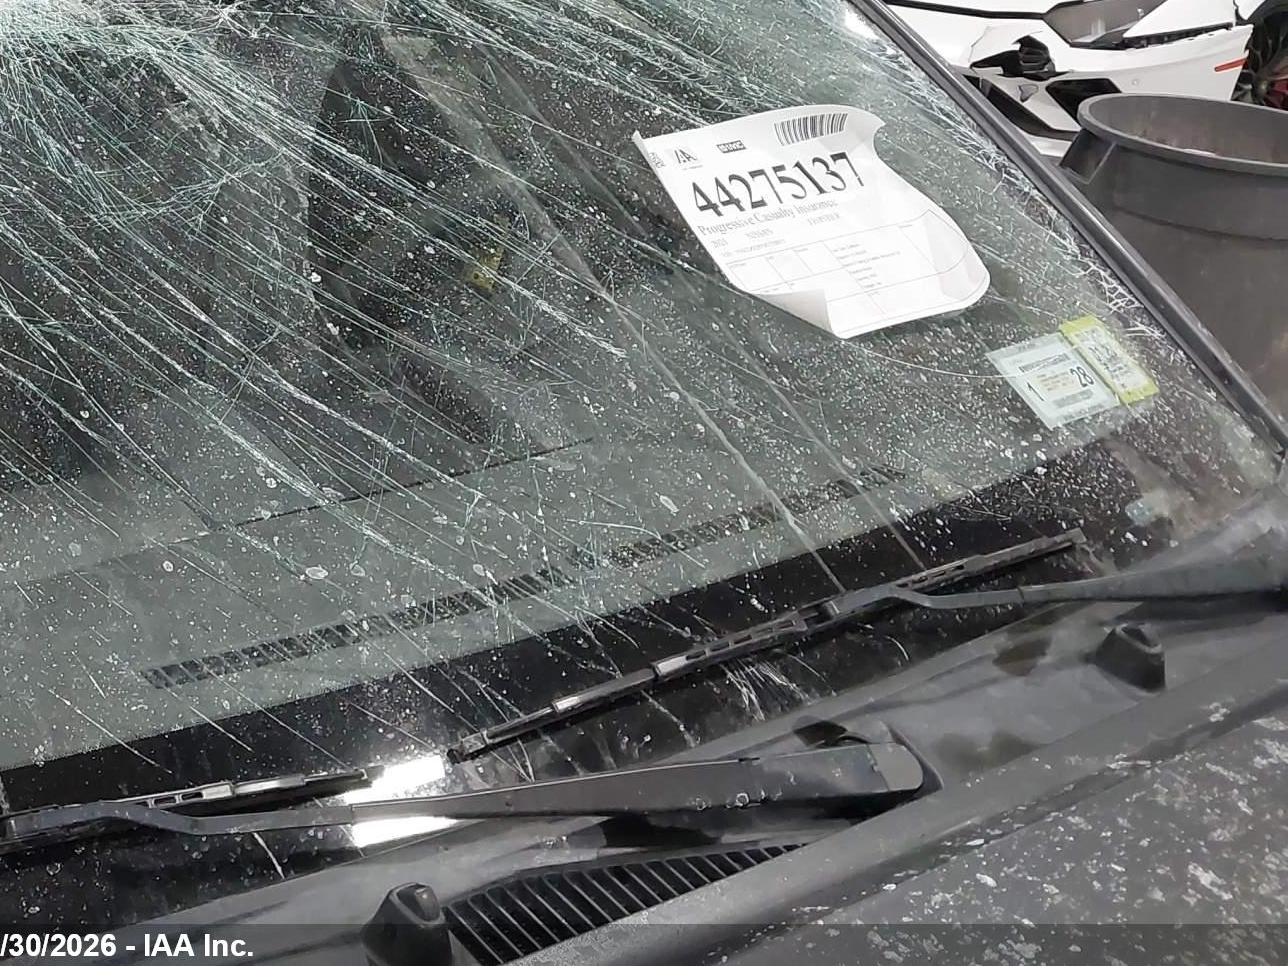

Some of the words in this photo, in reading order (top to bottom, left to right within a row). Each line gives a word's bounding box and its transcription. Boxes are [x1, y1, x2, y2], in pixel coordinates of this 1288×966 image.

[691, 151, 865, 218] 44275137
[697, 216, 755, 236] Progressive
[753, 206, 796, 223] Casualty
[794, 199, 839, 215] Insurance
[1069, 366, 1095, 388] 28
